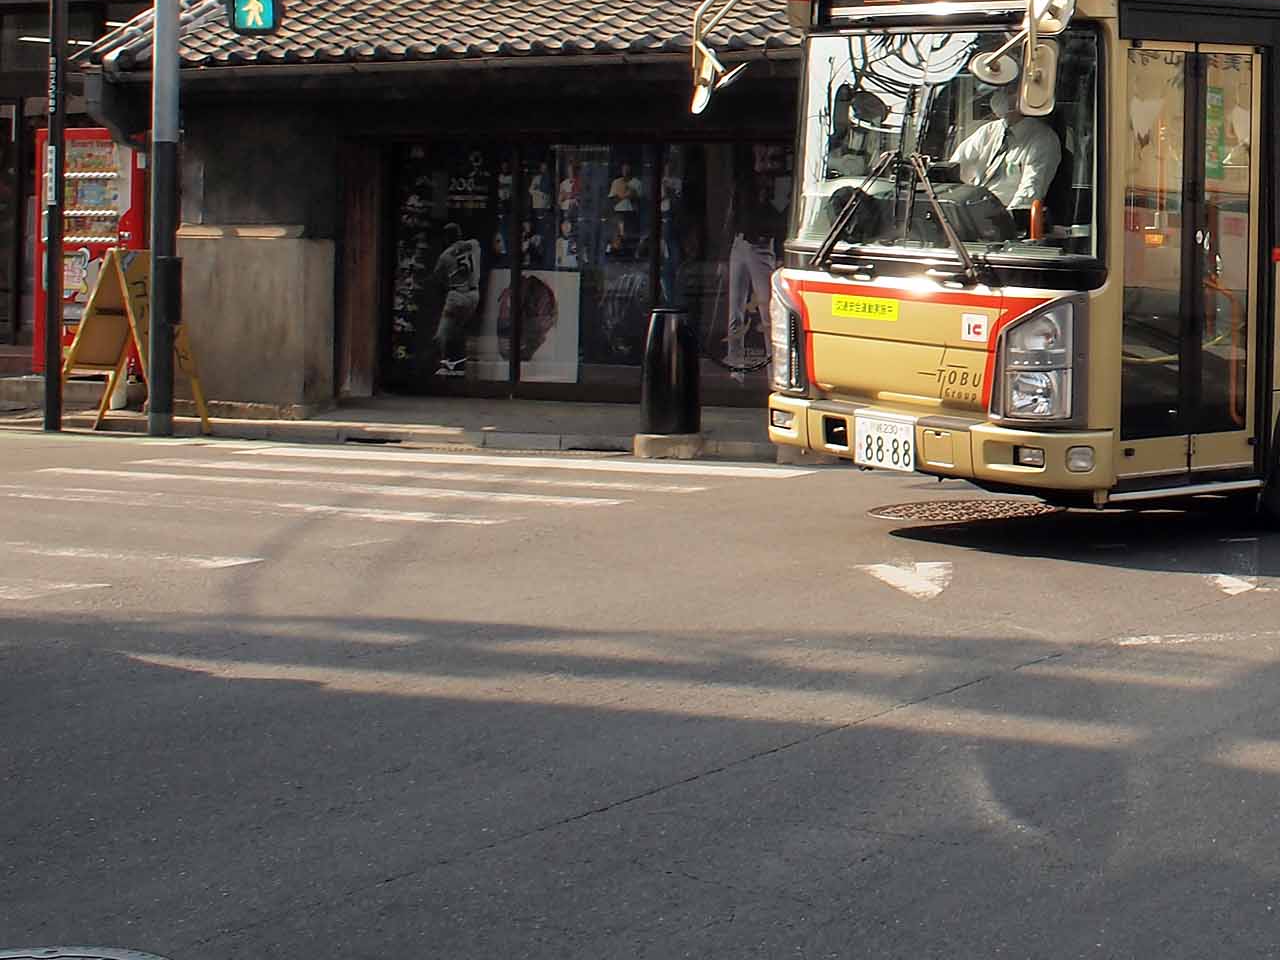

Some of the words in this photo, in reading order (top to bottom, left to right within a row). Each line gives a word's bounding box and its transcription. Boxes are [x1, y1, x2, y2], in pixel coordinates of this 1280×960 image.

[967, 323, 982, 336] IC
[936, 368, 982, 388] TOBU
[944, 387, 977, 401] Group
